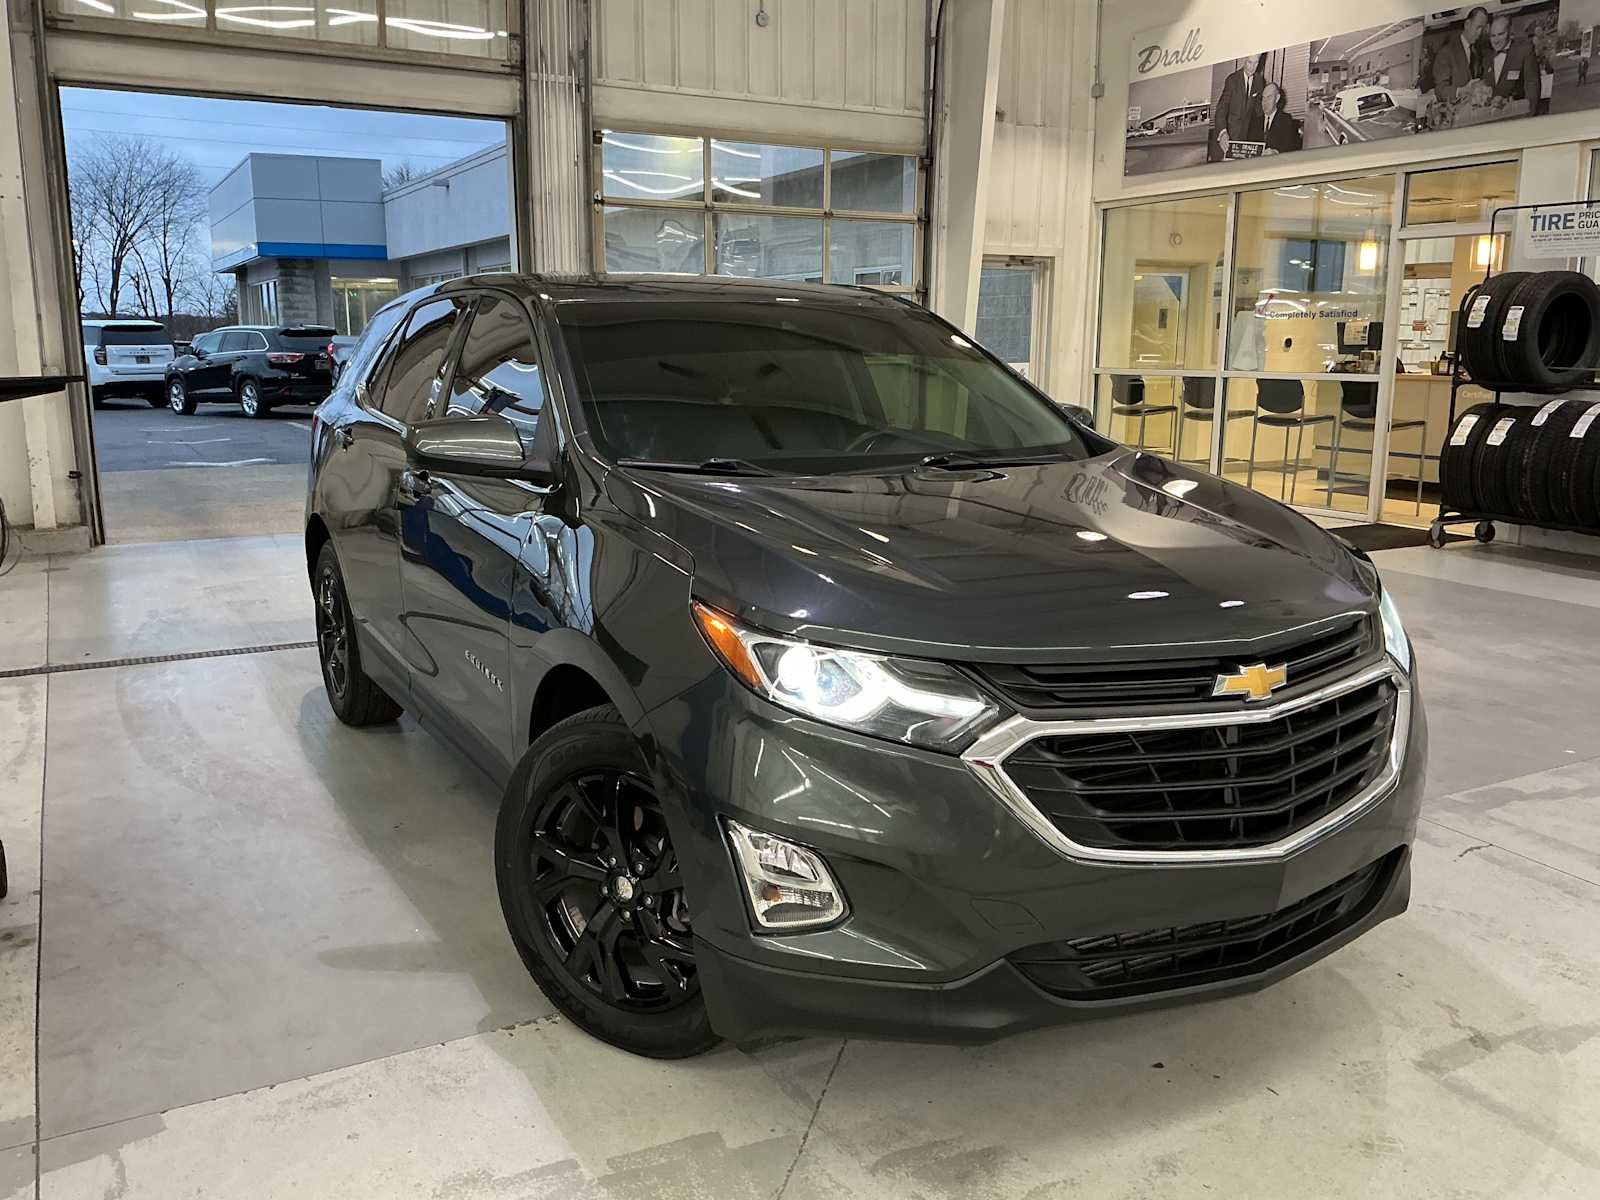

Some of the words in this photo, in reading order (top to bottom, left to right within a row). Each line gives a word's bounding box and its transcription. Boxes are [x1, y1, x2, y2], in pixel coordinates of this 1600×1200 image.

[1138, 27, 1205, 74] Dralle
[1530, 212, 1576, 232] TIRE
[1269, 310, 1317, 320] Completely
[1319, 309, 1358, 319] Satisfied
